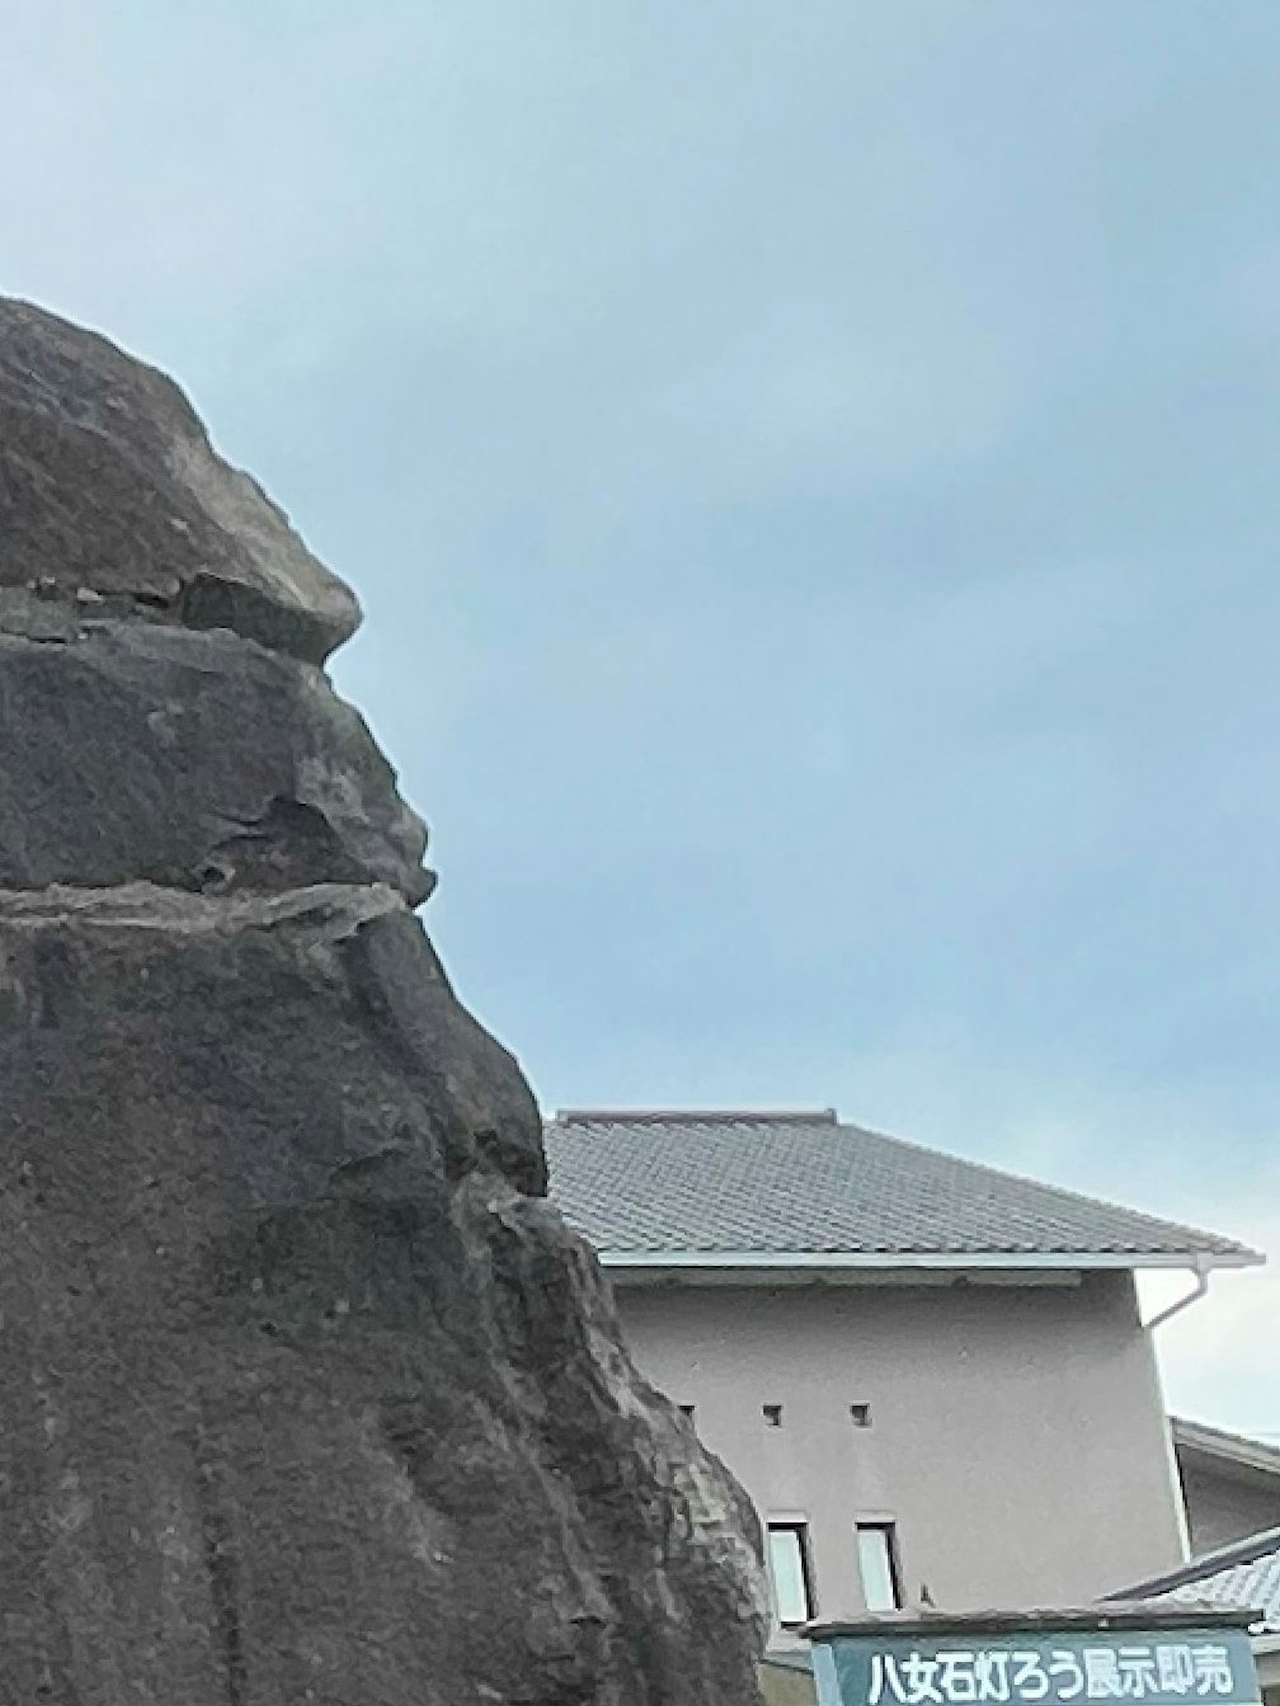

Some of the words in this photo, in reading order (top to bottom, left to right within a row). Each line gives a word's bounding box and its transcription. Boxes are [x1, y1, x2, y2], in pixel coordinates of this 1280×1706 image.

[869, 1645, 1234, 1705] 八女石灯ろう展示即売
